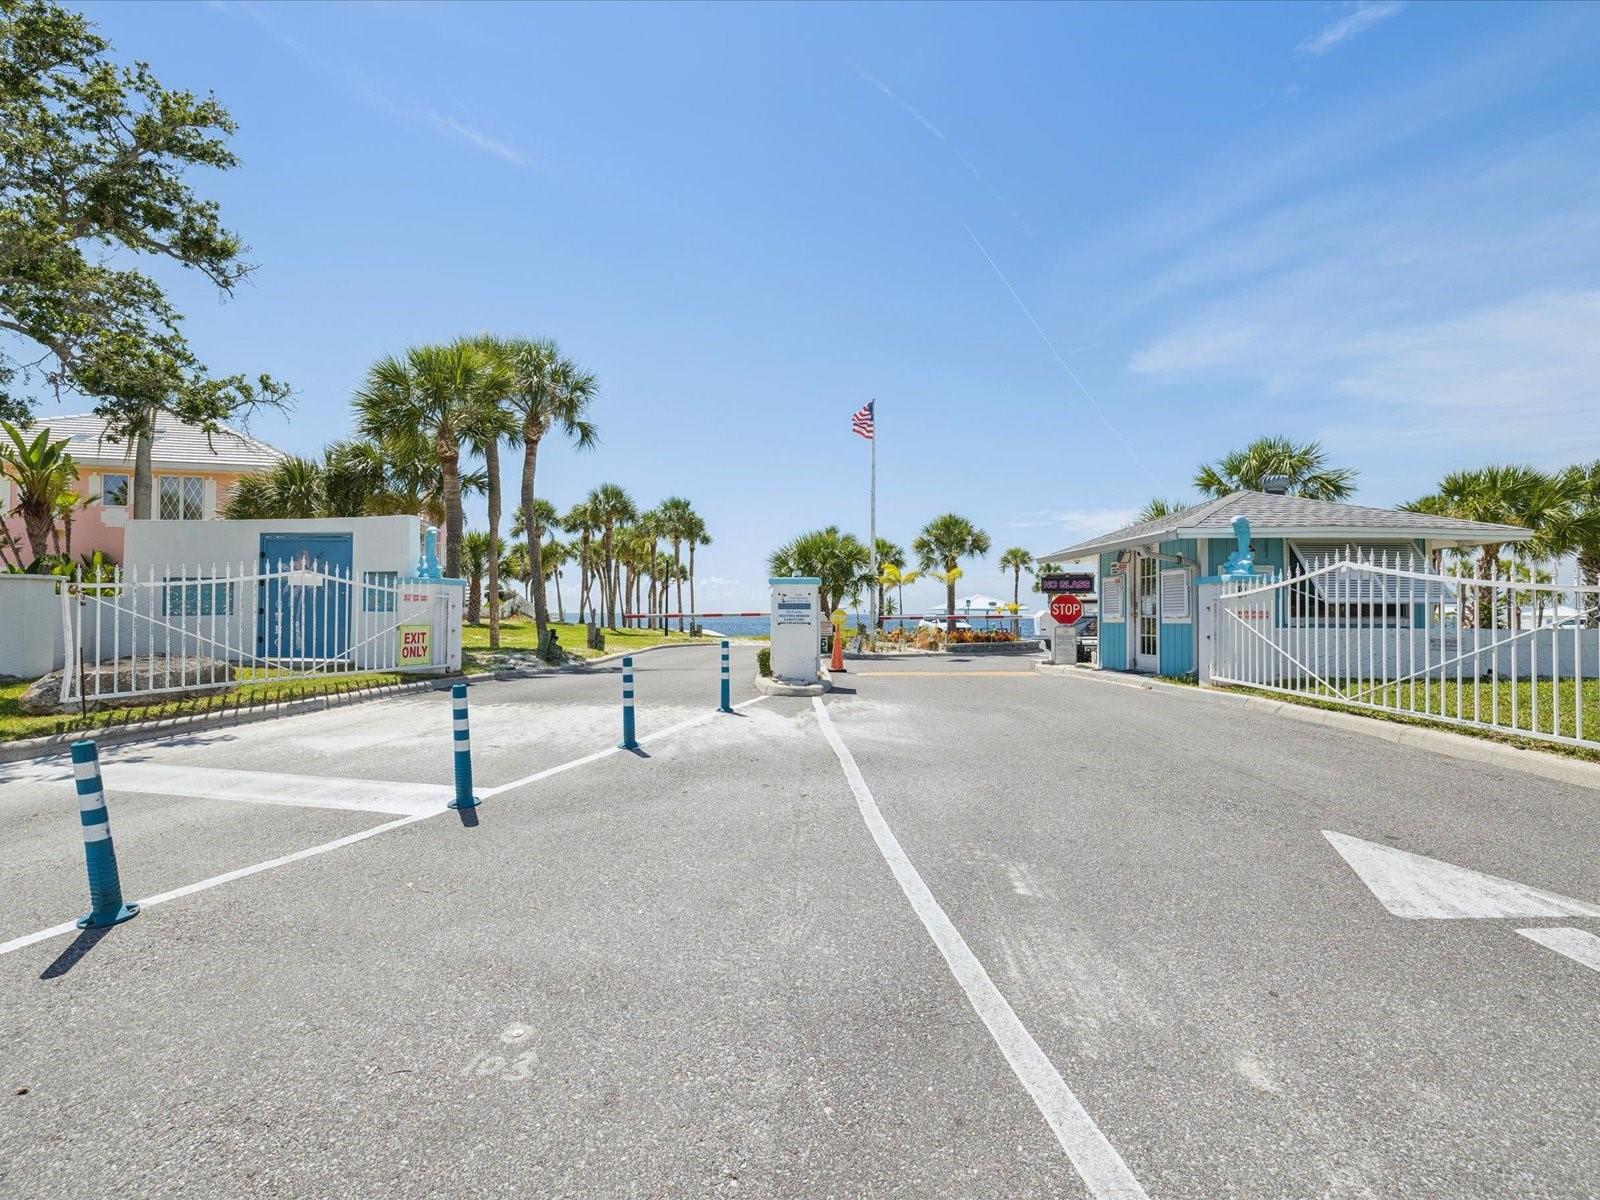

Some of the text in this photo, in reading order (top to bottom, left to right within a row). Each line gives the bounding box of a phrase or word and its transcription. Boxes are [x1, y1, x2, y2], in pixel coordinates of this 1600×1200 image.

[1043, 580, 1090, 589] NO GLASS
[1052, 603, 1080, 616] STOP
[405, 632, 426, 644] EXIT
[402, 646, 428, 659] ONLY
